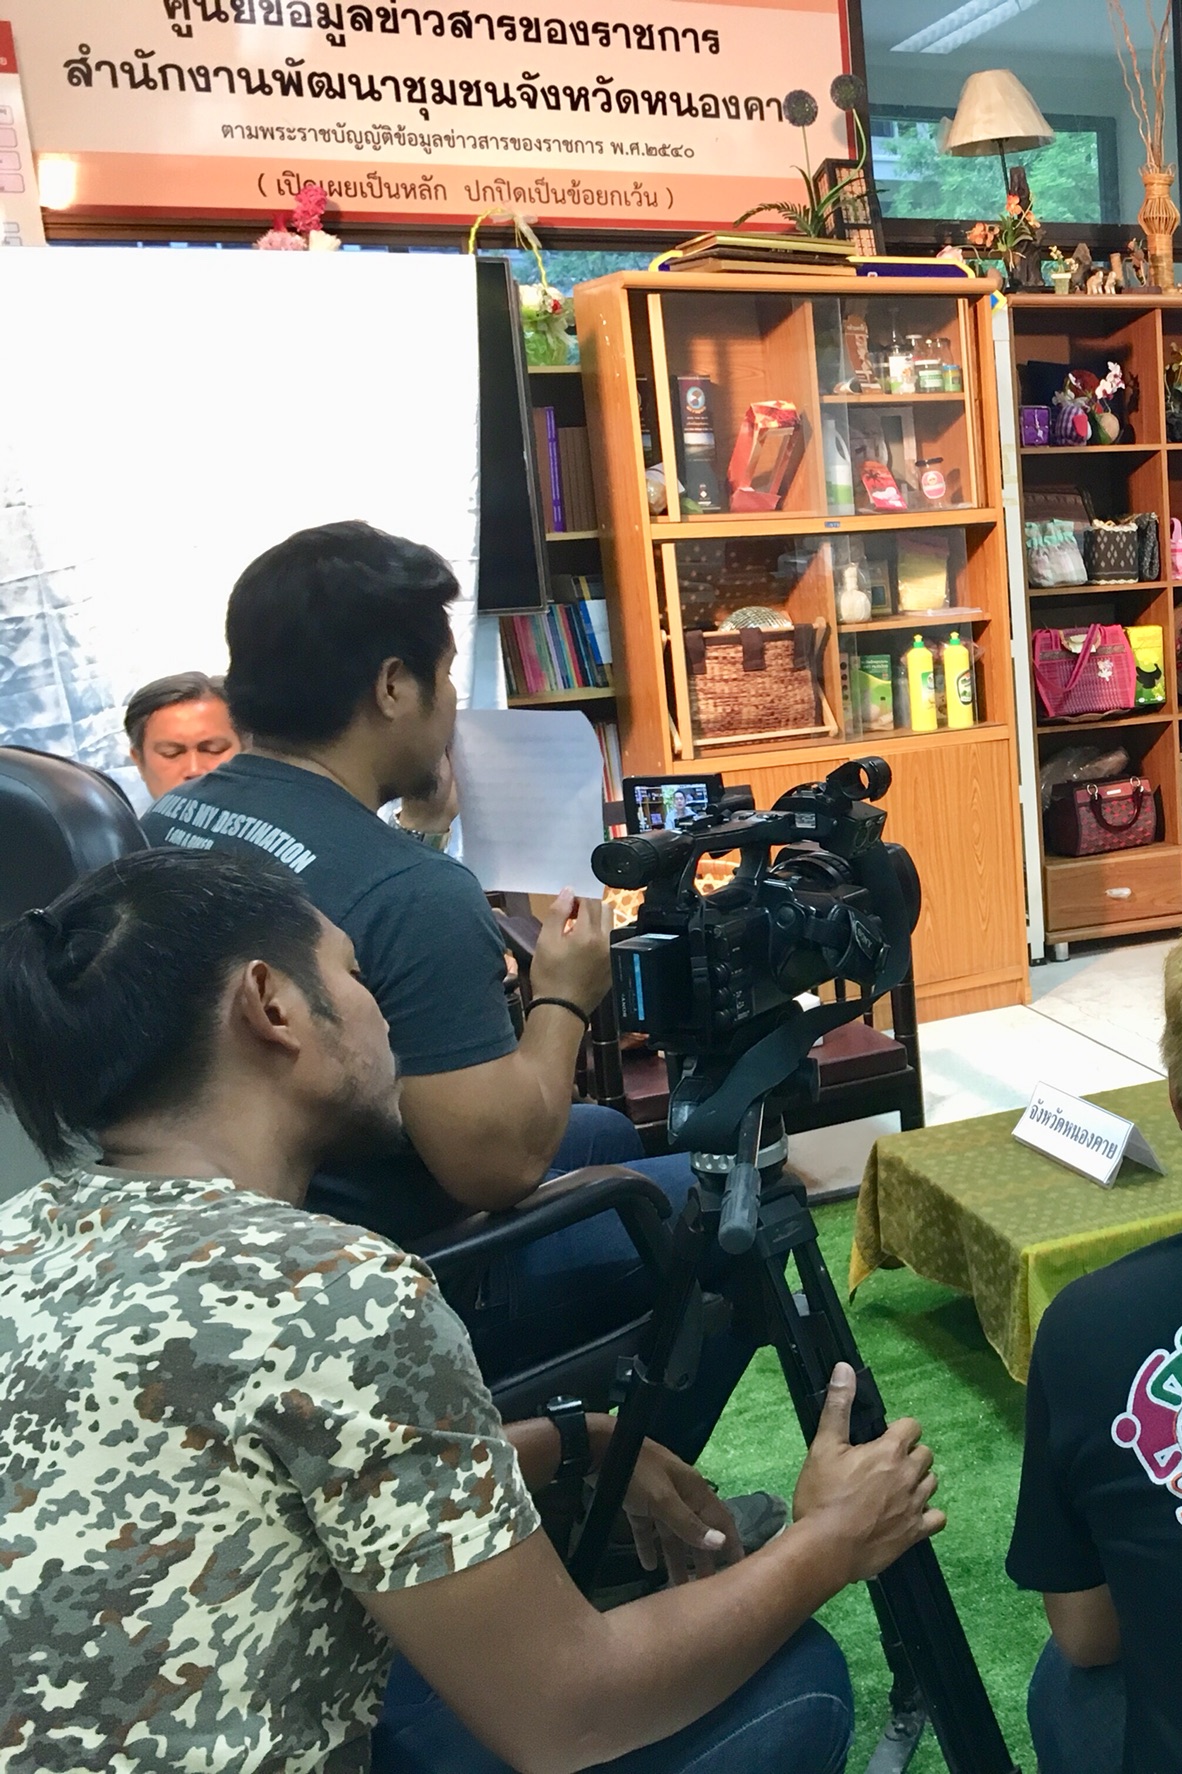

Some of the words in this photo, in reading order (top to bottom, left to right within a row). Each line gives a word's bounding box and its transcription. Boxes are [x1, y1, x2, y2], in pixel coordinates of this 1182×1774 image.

[164, 0, 720, 55] ศูนยขอมูลขาวสารของราชการ
[62, 43, 785, 123] สำนักงานพัฒนาชุมชนจังหวัดหนองคา
[221, 122, 604, 156] ตามพระราชบัญญัติข้อมูลข่าวสารของราชการ
[610, 139, 695, 159] พ.ศ.๒๕๔๐
[464, 177, 658, 209] ปกปิดเป็นข้อยกเว้น
[178, 799, 199, 824] IS
[192, 803, 220, 830] MY
[210, 809, 317, 874] DESTINATION
[1029, 1098, 1119, 1160] จังหวัดหนองคาย
